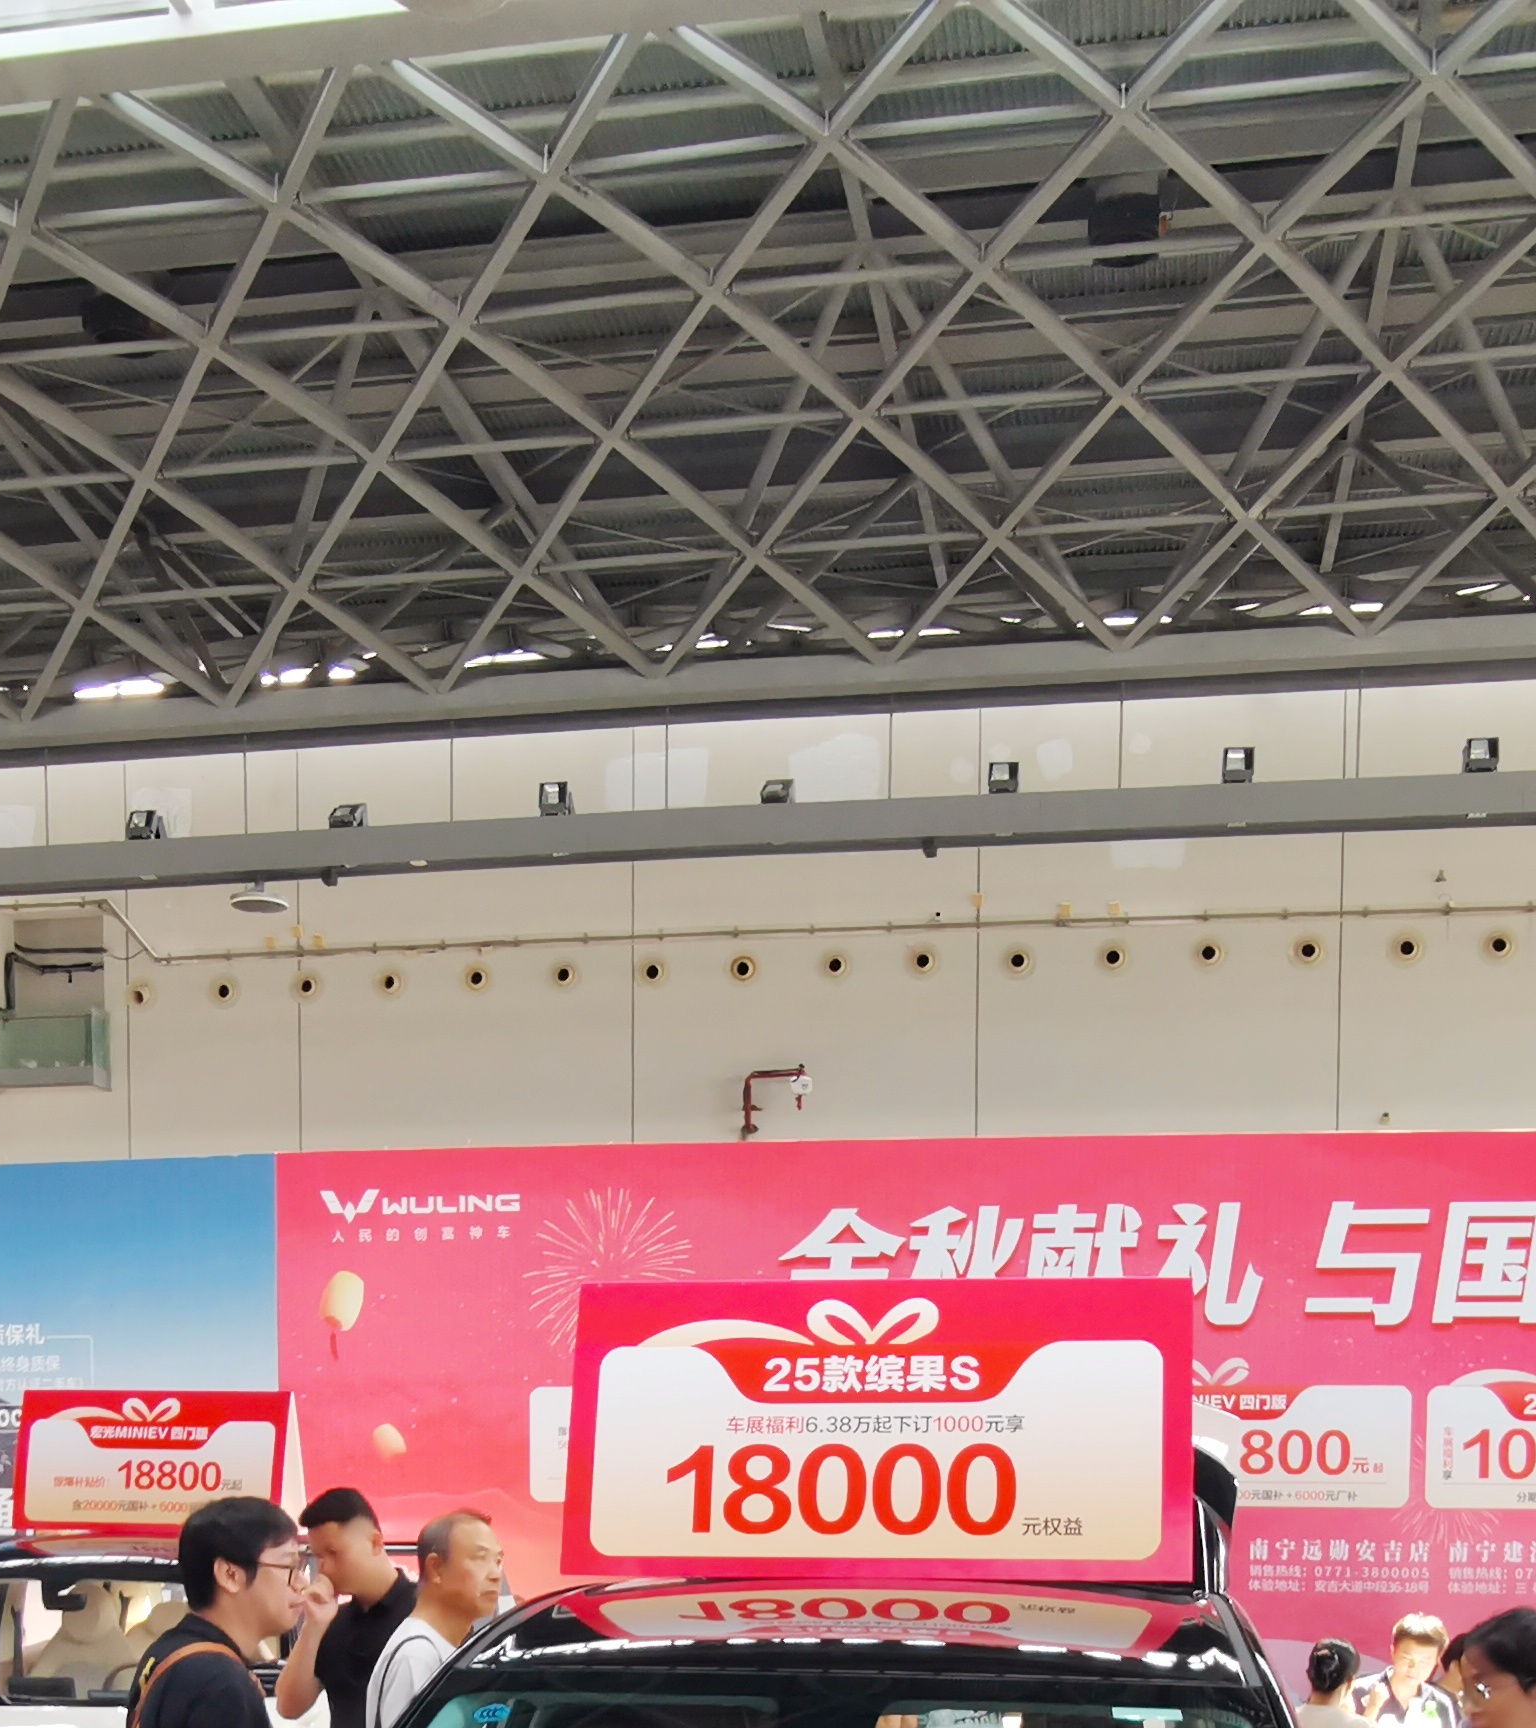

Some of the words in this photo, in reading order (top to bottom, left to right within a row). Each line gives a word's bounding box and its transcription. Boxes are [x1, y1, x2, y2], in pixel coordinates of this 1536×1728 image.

[381, 1193, 521, 1215] WULING
[763, 1355, 981, 1395] 25款缤果S
[117, 1459, 223, 1493] 18800
[665, 1441, 1018, 1537] 18000
